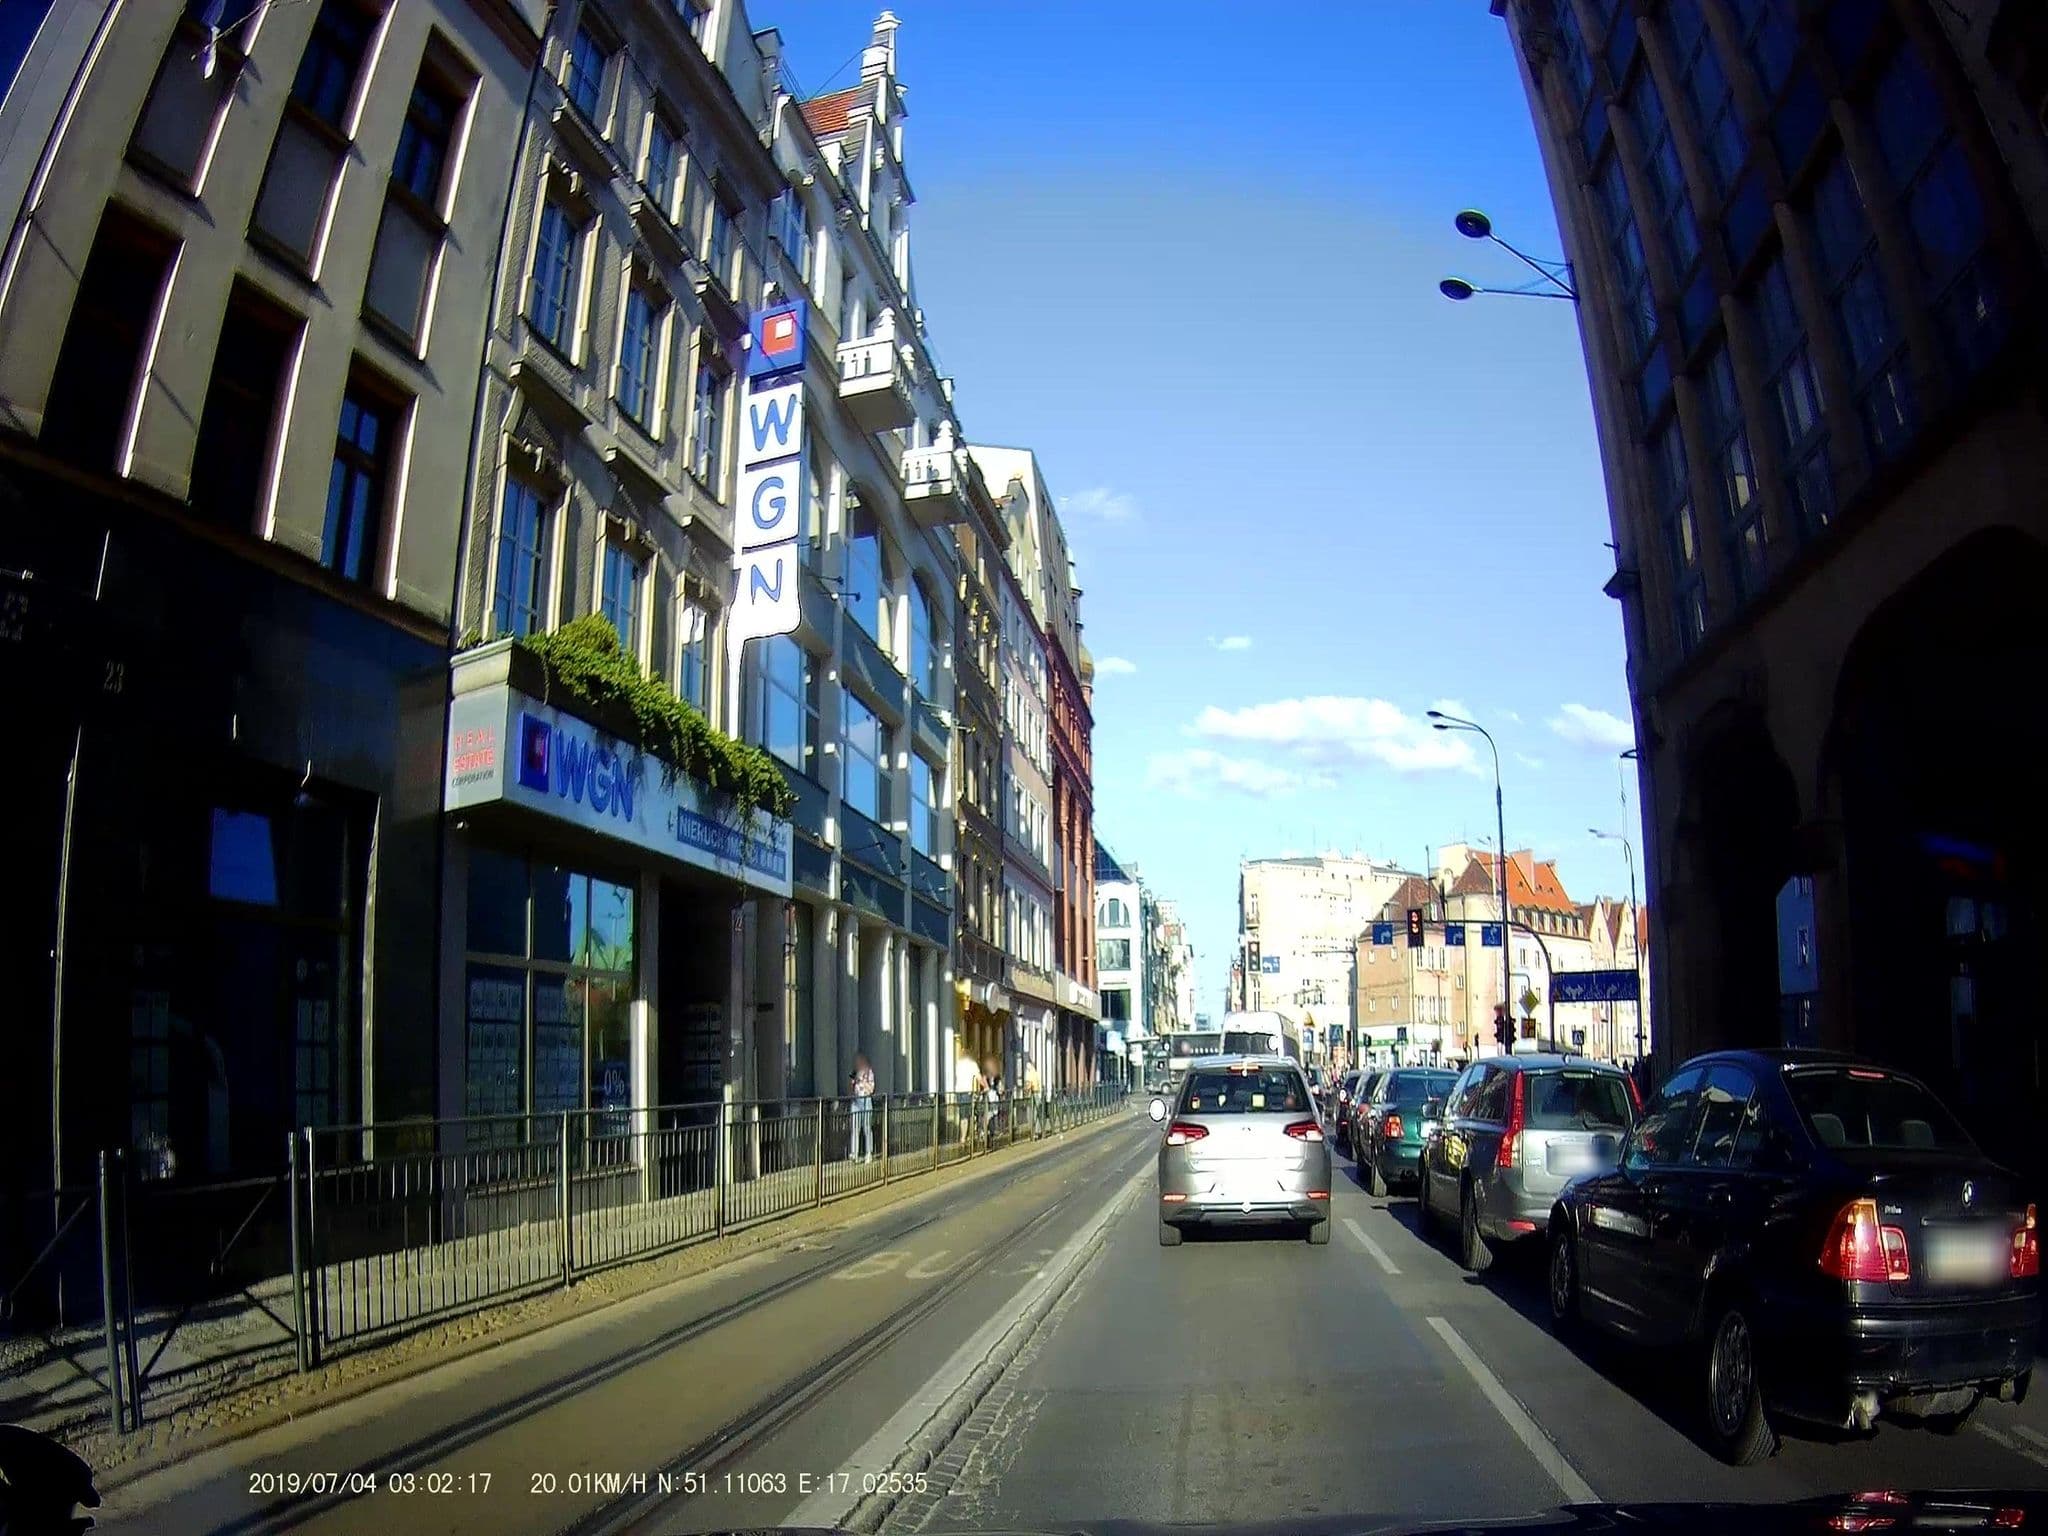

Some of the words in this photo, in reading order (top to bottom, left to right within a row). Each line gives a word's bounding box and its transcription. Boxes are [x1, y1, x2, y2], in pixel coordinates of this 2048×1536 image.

[750, 393, 797, 604] WGN
[453, 748, 495, 775] ESTATE
[556, 729, 634, 822] WGN
